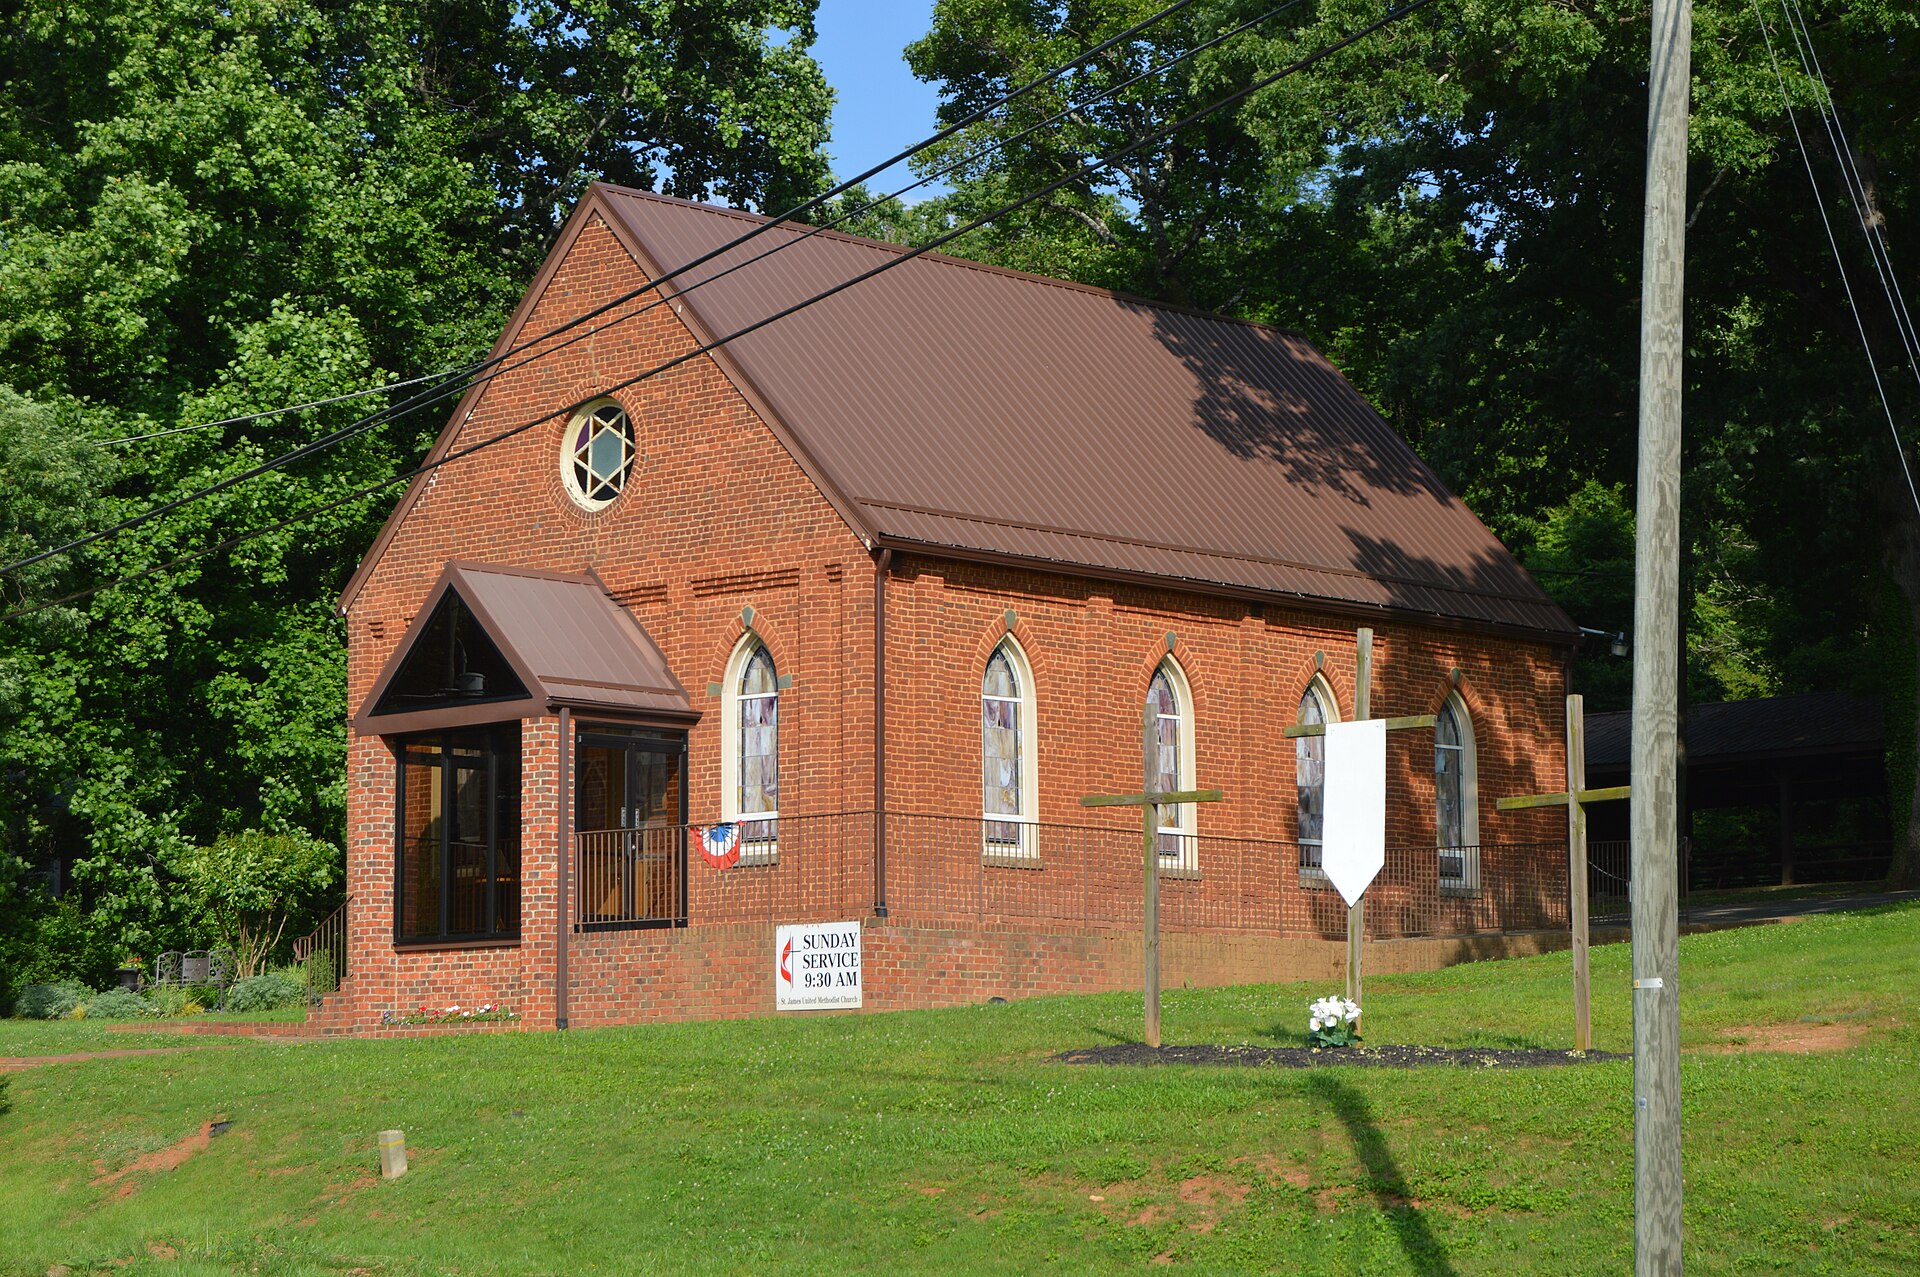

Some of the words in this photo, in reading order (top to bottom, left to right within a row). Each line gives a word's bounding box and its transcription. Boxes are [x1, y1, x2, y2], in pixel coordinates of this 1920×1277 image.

[803, 932, 857, 949] SUNDAY
[803, 952, 858, 969] SERVICE
[805, 972, 831, 988] 9:30
[836, 972, 857, 987] AM
[818, 996, 839, 1004] Methodist
